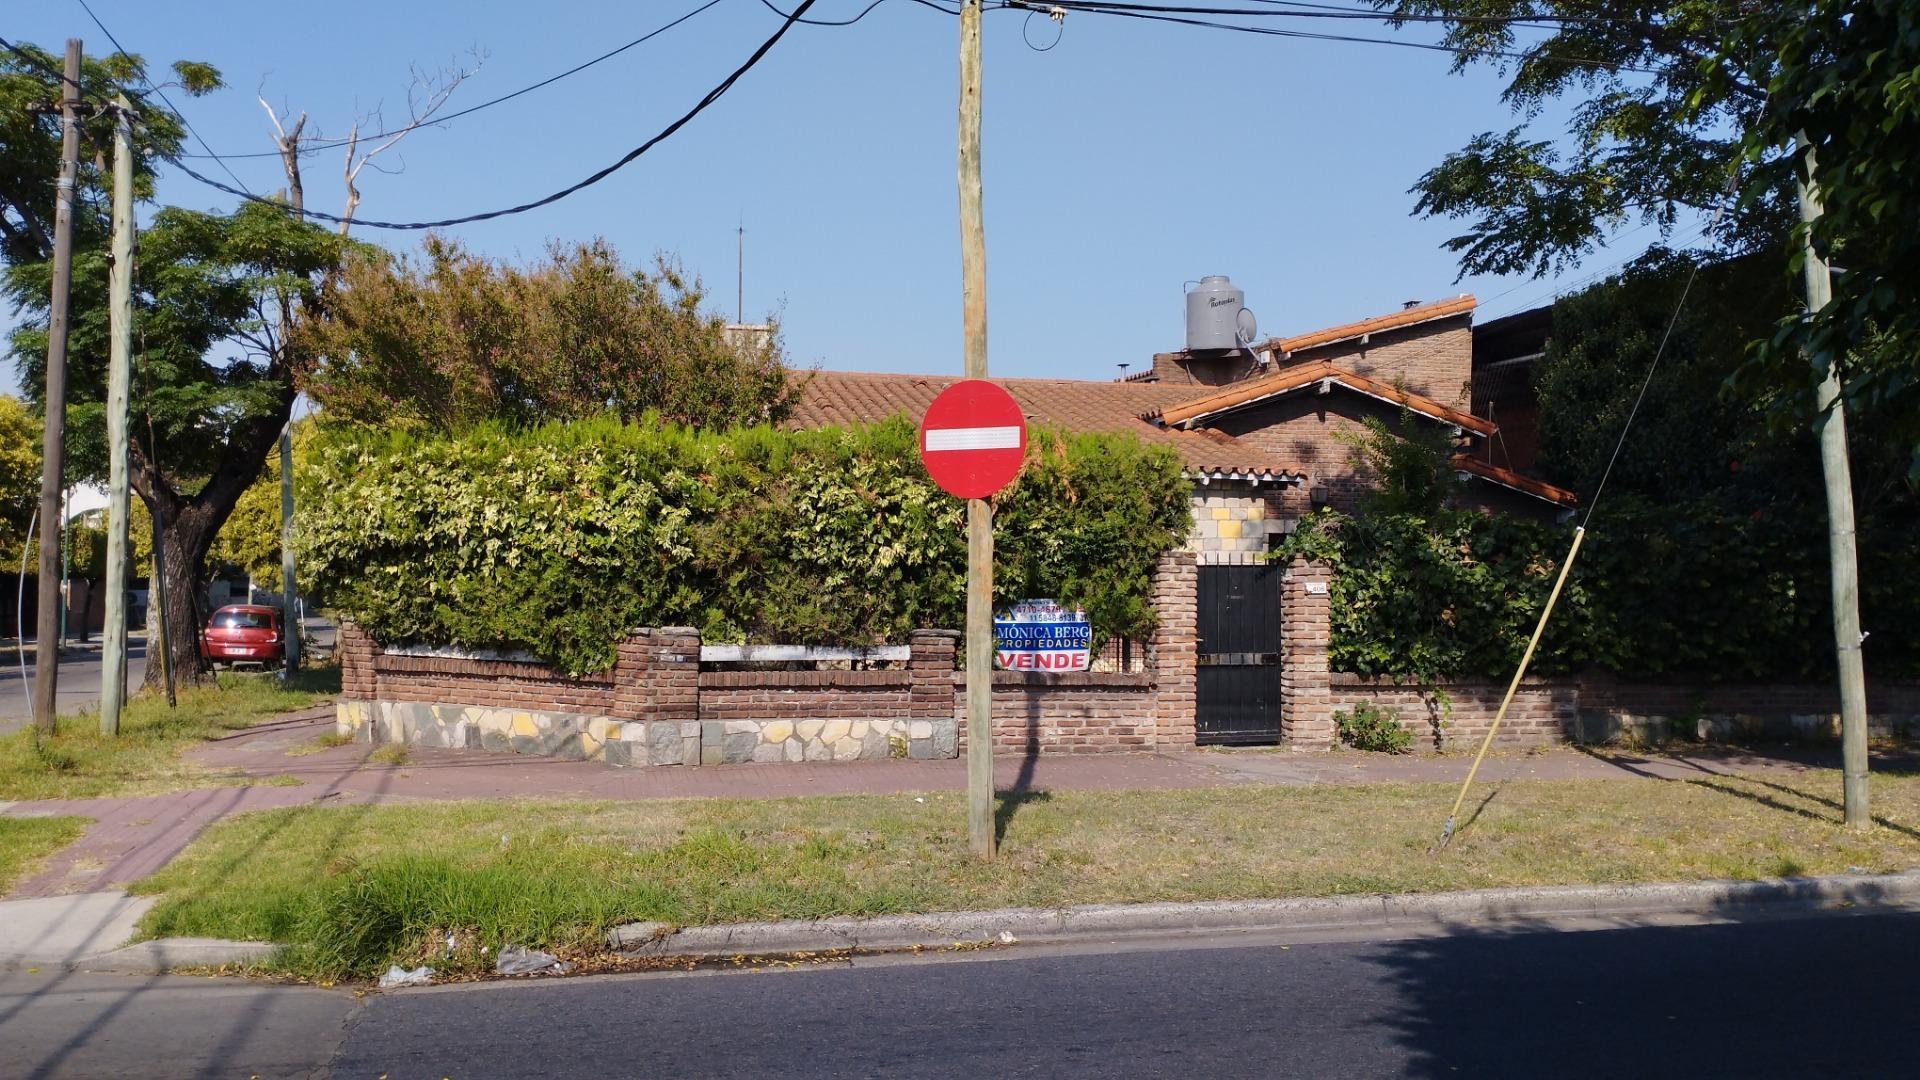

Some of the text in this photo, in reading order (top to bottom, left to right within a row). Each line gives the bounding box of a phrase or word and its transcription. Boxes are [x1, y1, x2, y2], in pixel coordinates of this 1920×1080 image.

[997, 624, 1089, 639] MÓNICA BERG
[998, 639, 1088, 648] PROPIEDADES
[997, 653, 1085, 669] VENDE
